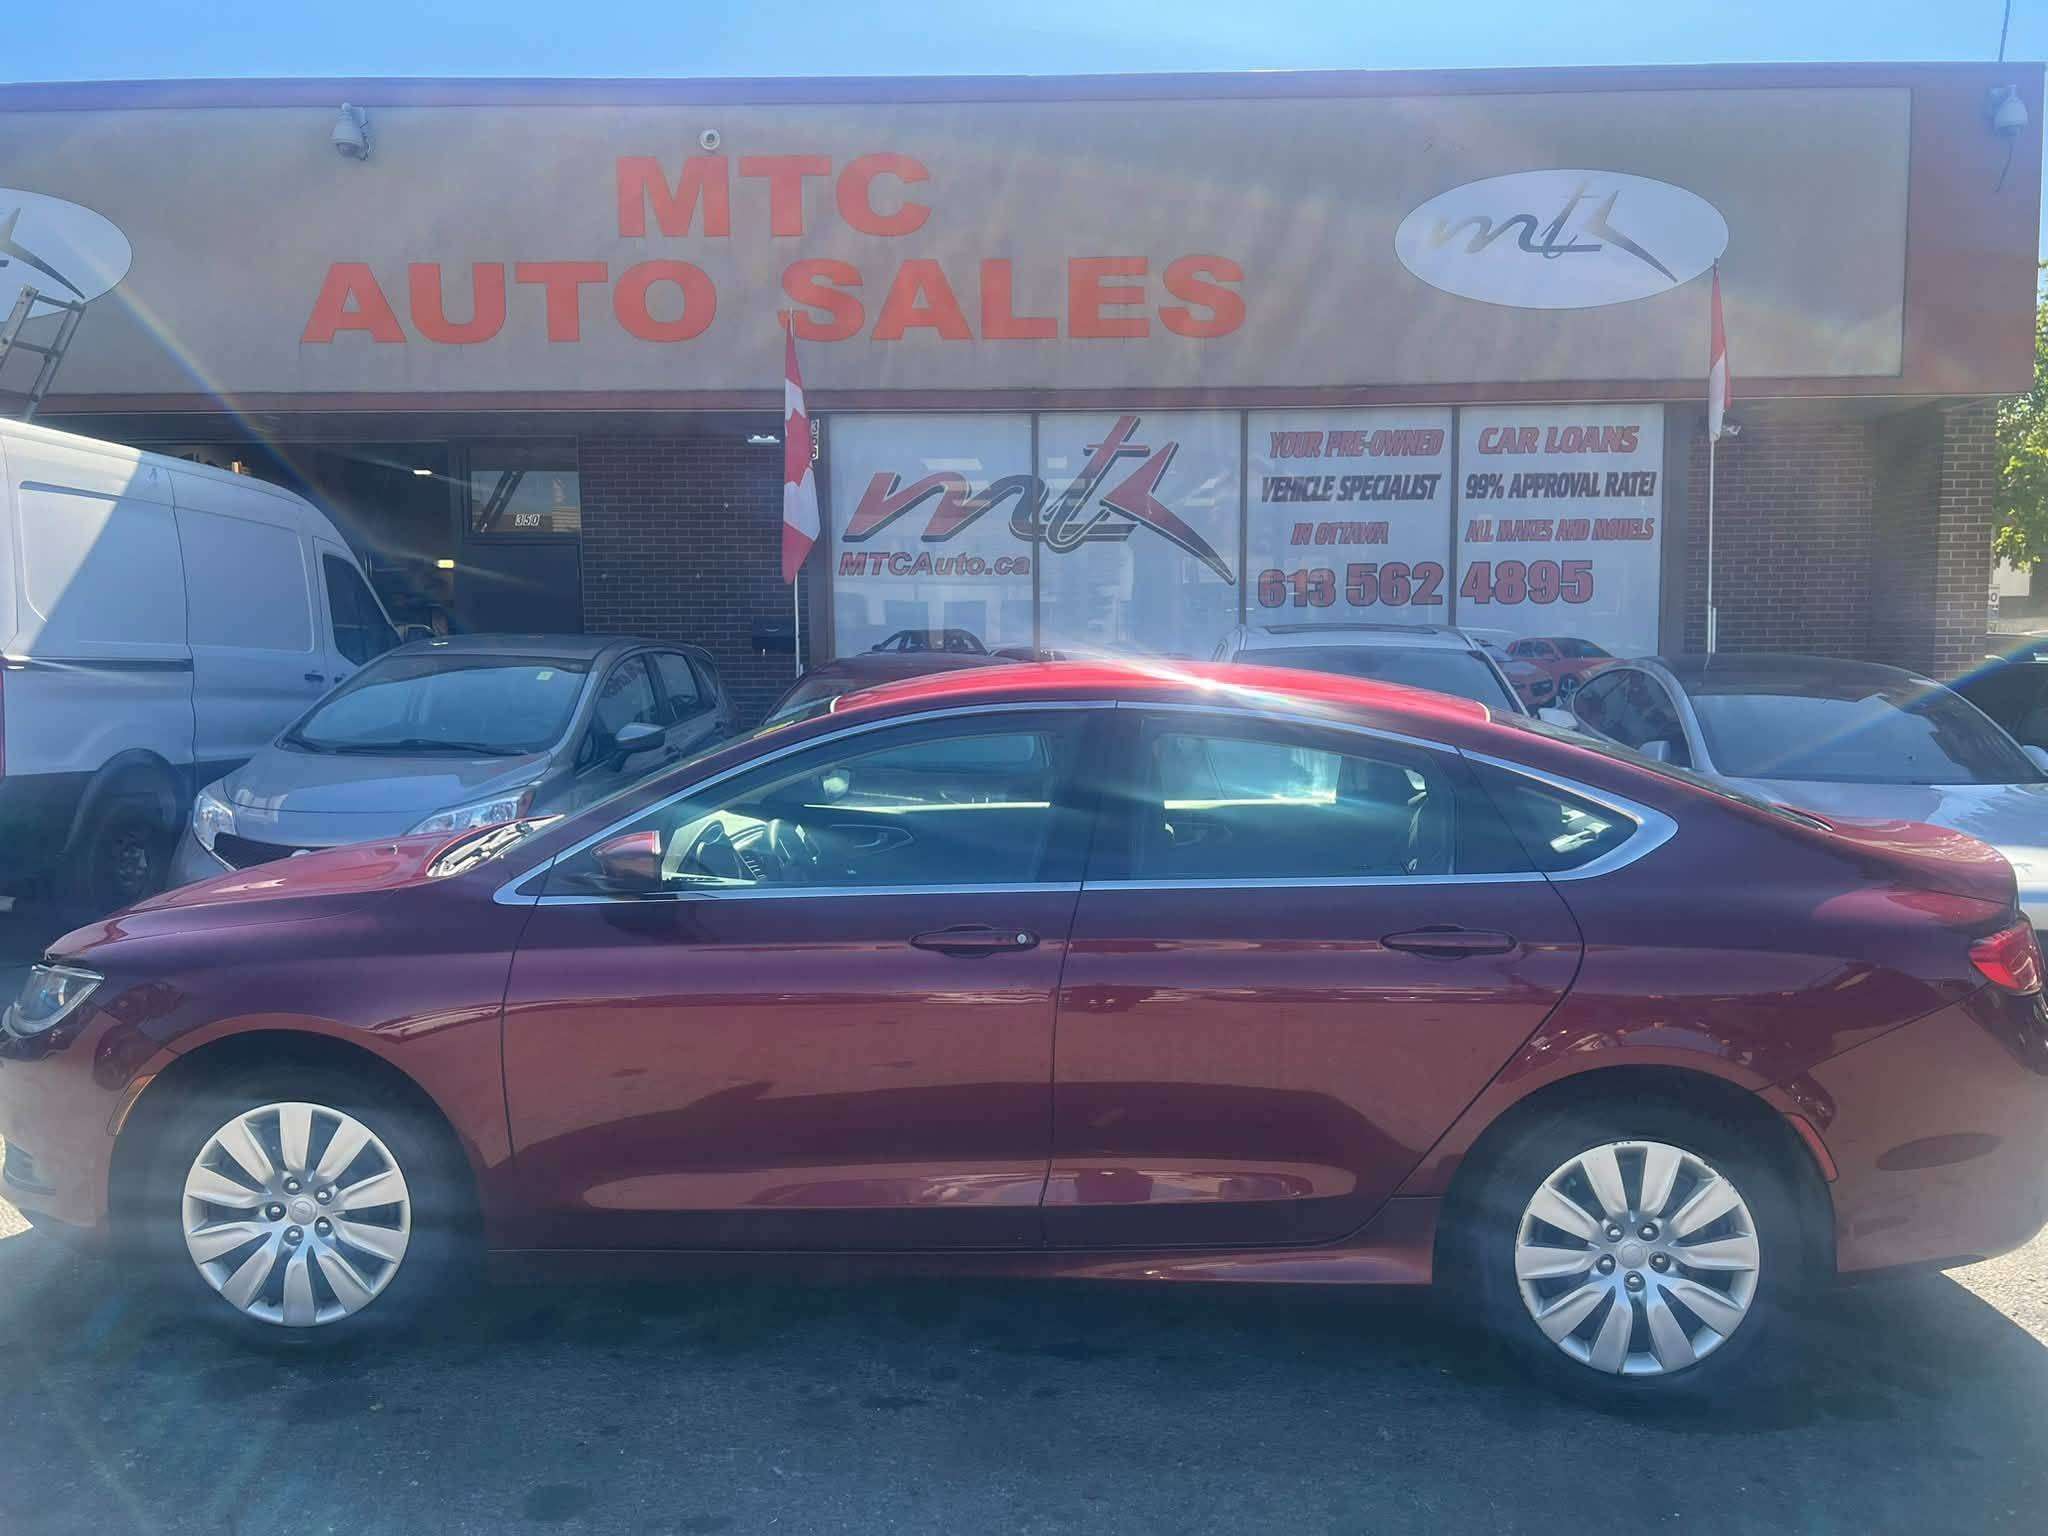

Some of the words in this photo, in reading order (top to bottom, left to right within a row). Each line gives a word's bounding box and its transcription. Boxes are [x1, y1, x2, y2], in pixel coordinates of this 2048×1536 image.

[616, 152, 931, 237] MTC
[301, 259, 717, 344] AUTO
[777, 254, 1246, 342] SALES
[1270, 431, 1323, 458] YOUR
[1324, 429, 1445, 458] PRE-OWNED
[1479, 427, 1540, 454] CAR
[1545, 425, 1640, 454] LOANS
[1262, 475, 1336, 502] VEHICLE
[1336, 473, 1442, 502] SPECIALIST
[1465, 473, 1504, 499] 99%
[1508, 471, 1600, 498] APPROVAL
[1604, 471, 1657, 497] RATE!
[514, 513, 541, 528] 350
[1290, 522, 1313, 545] IN
[1314, 521, 1389, 545] OTTAWA
[1465, 519, 1494, 542] ALL
[1496, 519, 1554, 542] MAKES
[1555, 518, 1590, 541] AND
[1592, 517, 1655, 541] MODELS
[838, 551, 1030, 576] MTCAuto.ca
[1258, 568, 1336, 608] 613
[1345, 561, 1444, 607] 562
[1460, 560, 1594, 605] 4895
